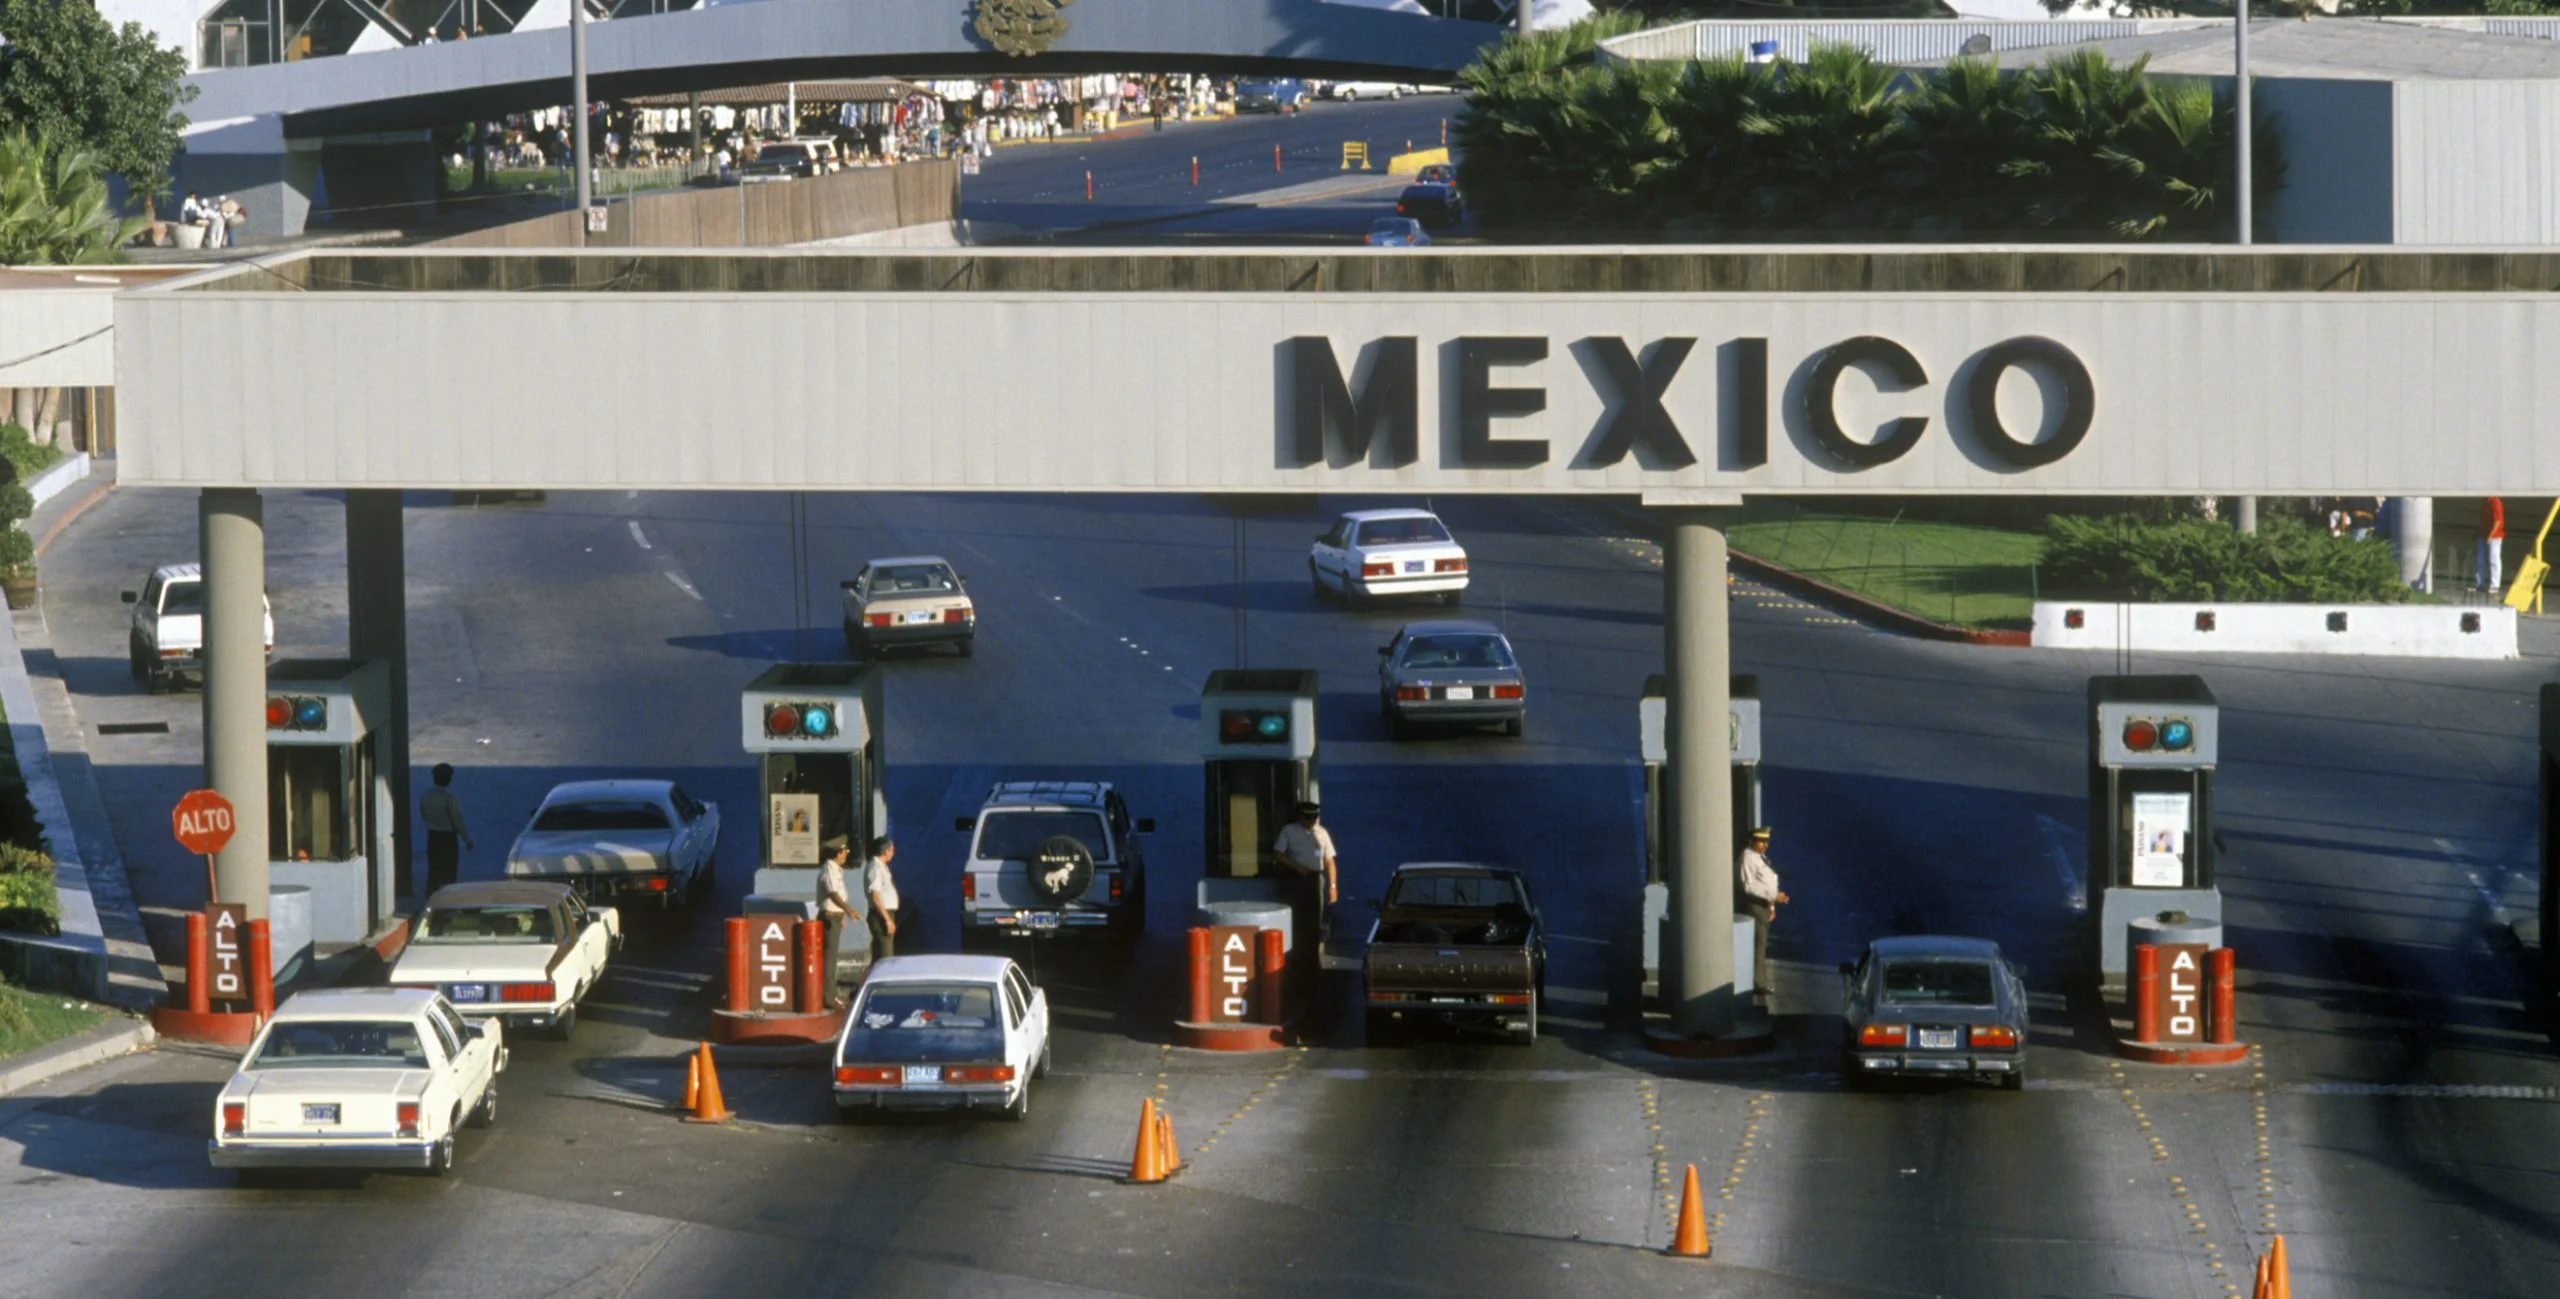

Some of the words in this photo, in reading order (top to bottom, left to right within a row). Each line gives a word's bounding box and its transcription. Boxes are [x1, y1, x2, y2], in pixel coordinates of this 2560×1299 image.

[1283, 335, 2095, 474] MEXICO
[179, 807, 231, 836] ALTO
[215, 910, 239, 993] ALTO
[760, 921, 787, 1005] ALTO
[1222, 933, 1248, 1017] ALTO
[2169, 950, 2196, 1036] ALTO
